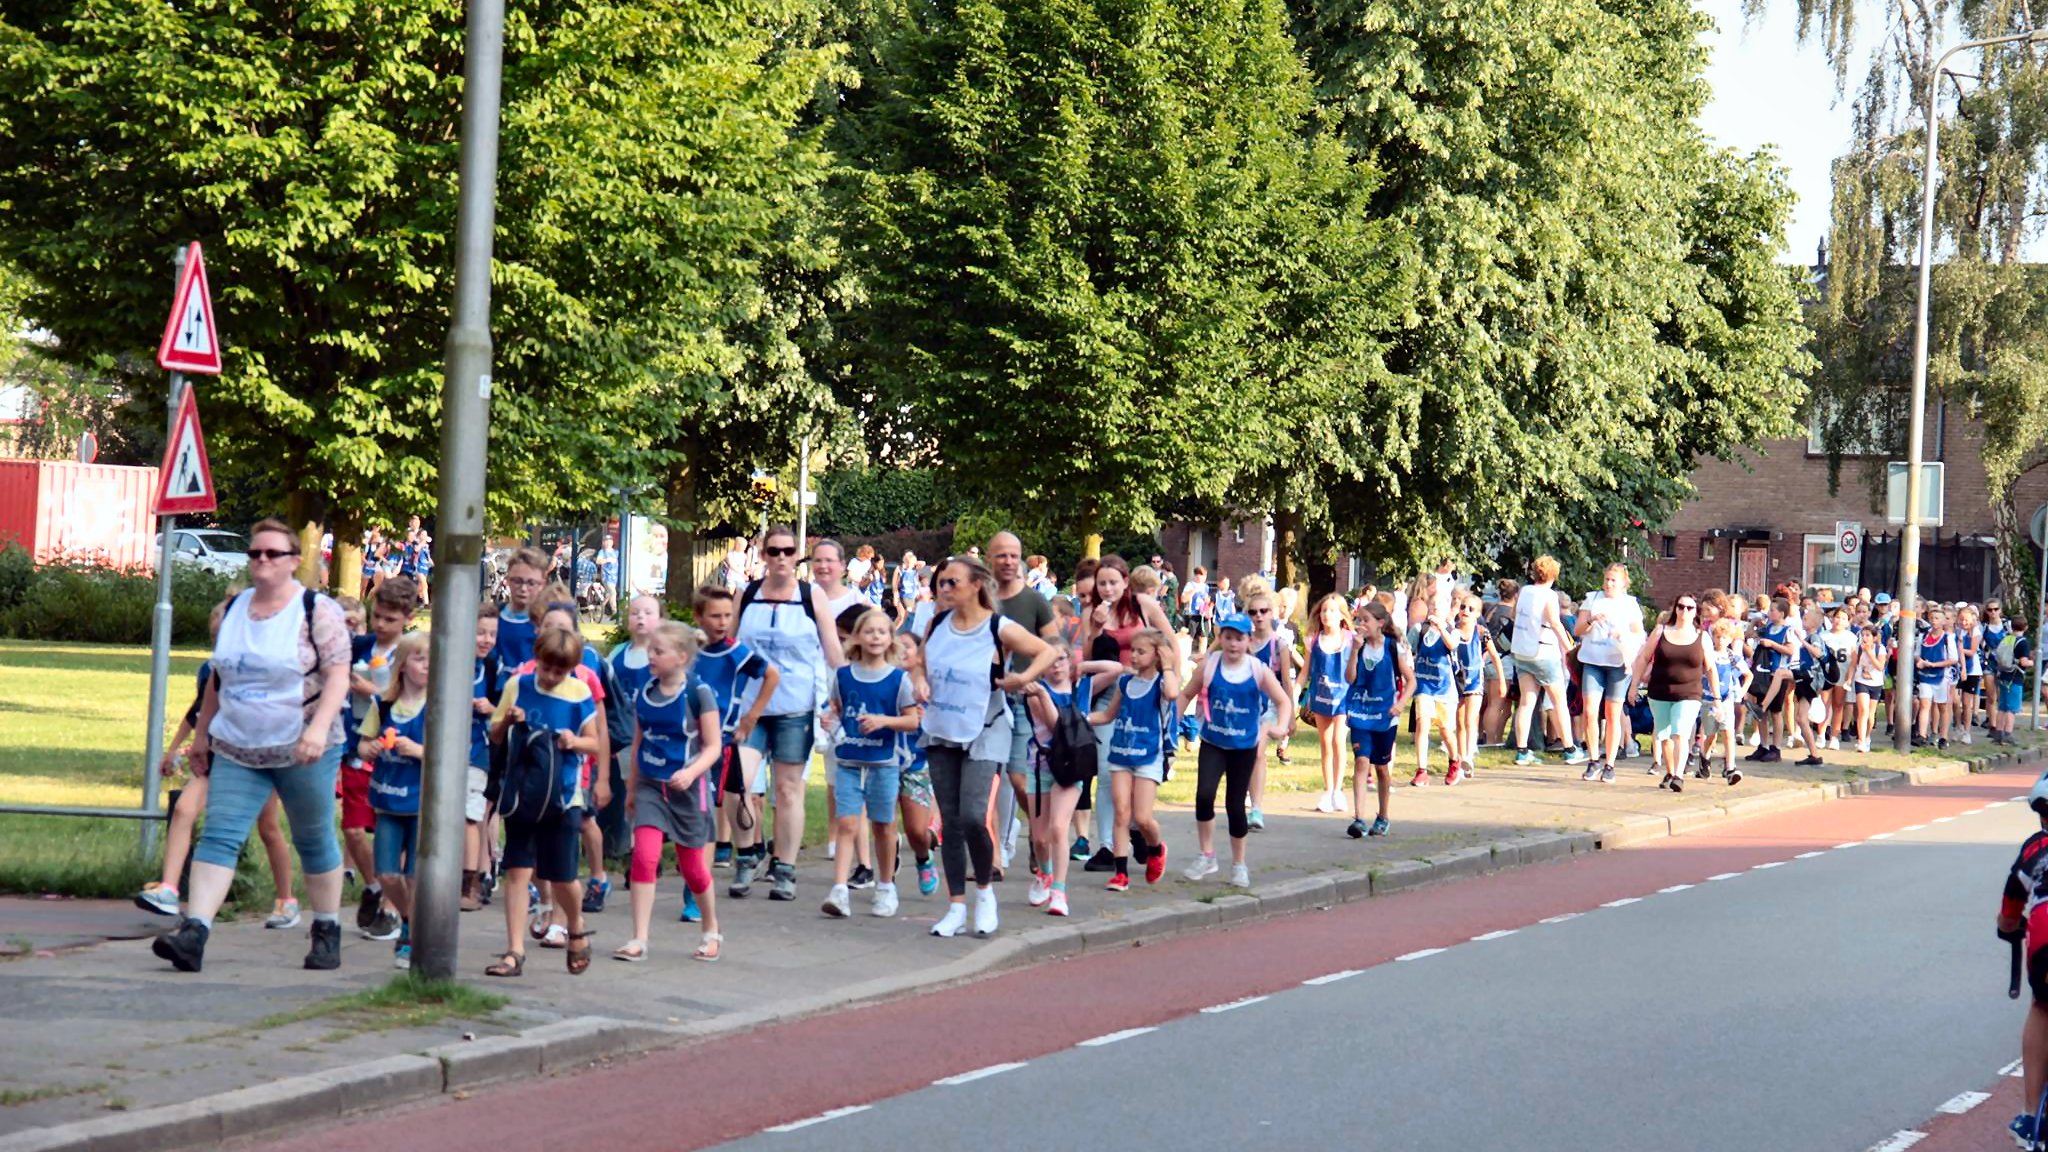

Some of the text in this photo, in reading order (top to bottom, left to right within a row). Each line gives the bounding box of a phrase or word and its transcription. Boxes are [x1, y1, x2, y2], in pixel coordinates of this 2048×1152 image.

[1843, 537, 1854, 548] 30
[1347, 709, 1382, 721] Hoogland
[1208, 723, 1247, 736] Hoogland
[843, 736, 883, 747] oogland
